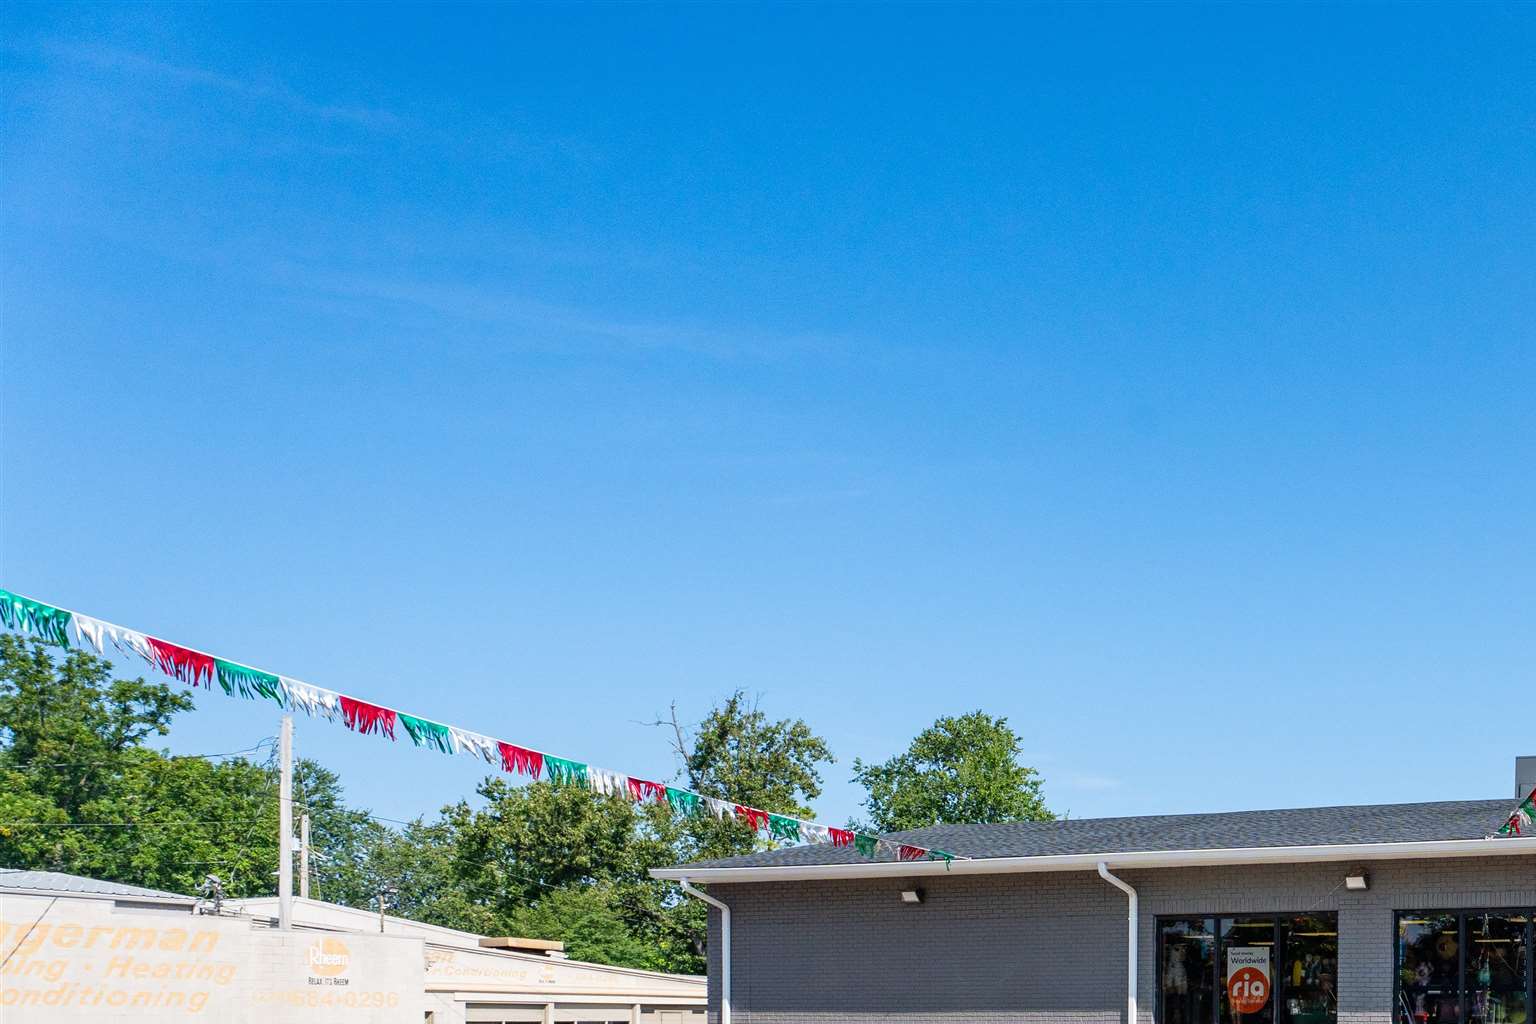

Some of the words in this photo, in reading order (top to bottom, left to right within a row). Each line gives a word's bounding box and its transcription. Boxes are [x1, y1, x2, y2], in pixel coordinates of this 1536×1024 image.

[0, 922, 222, 958] german
[309, 936, 349, 967] Rheem
[106, 955, 237, 985] Heating
[1232, 973, 1265, 997] ria
